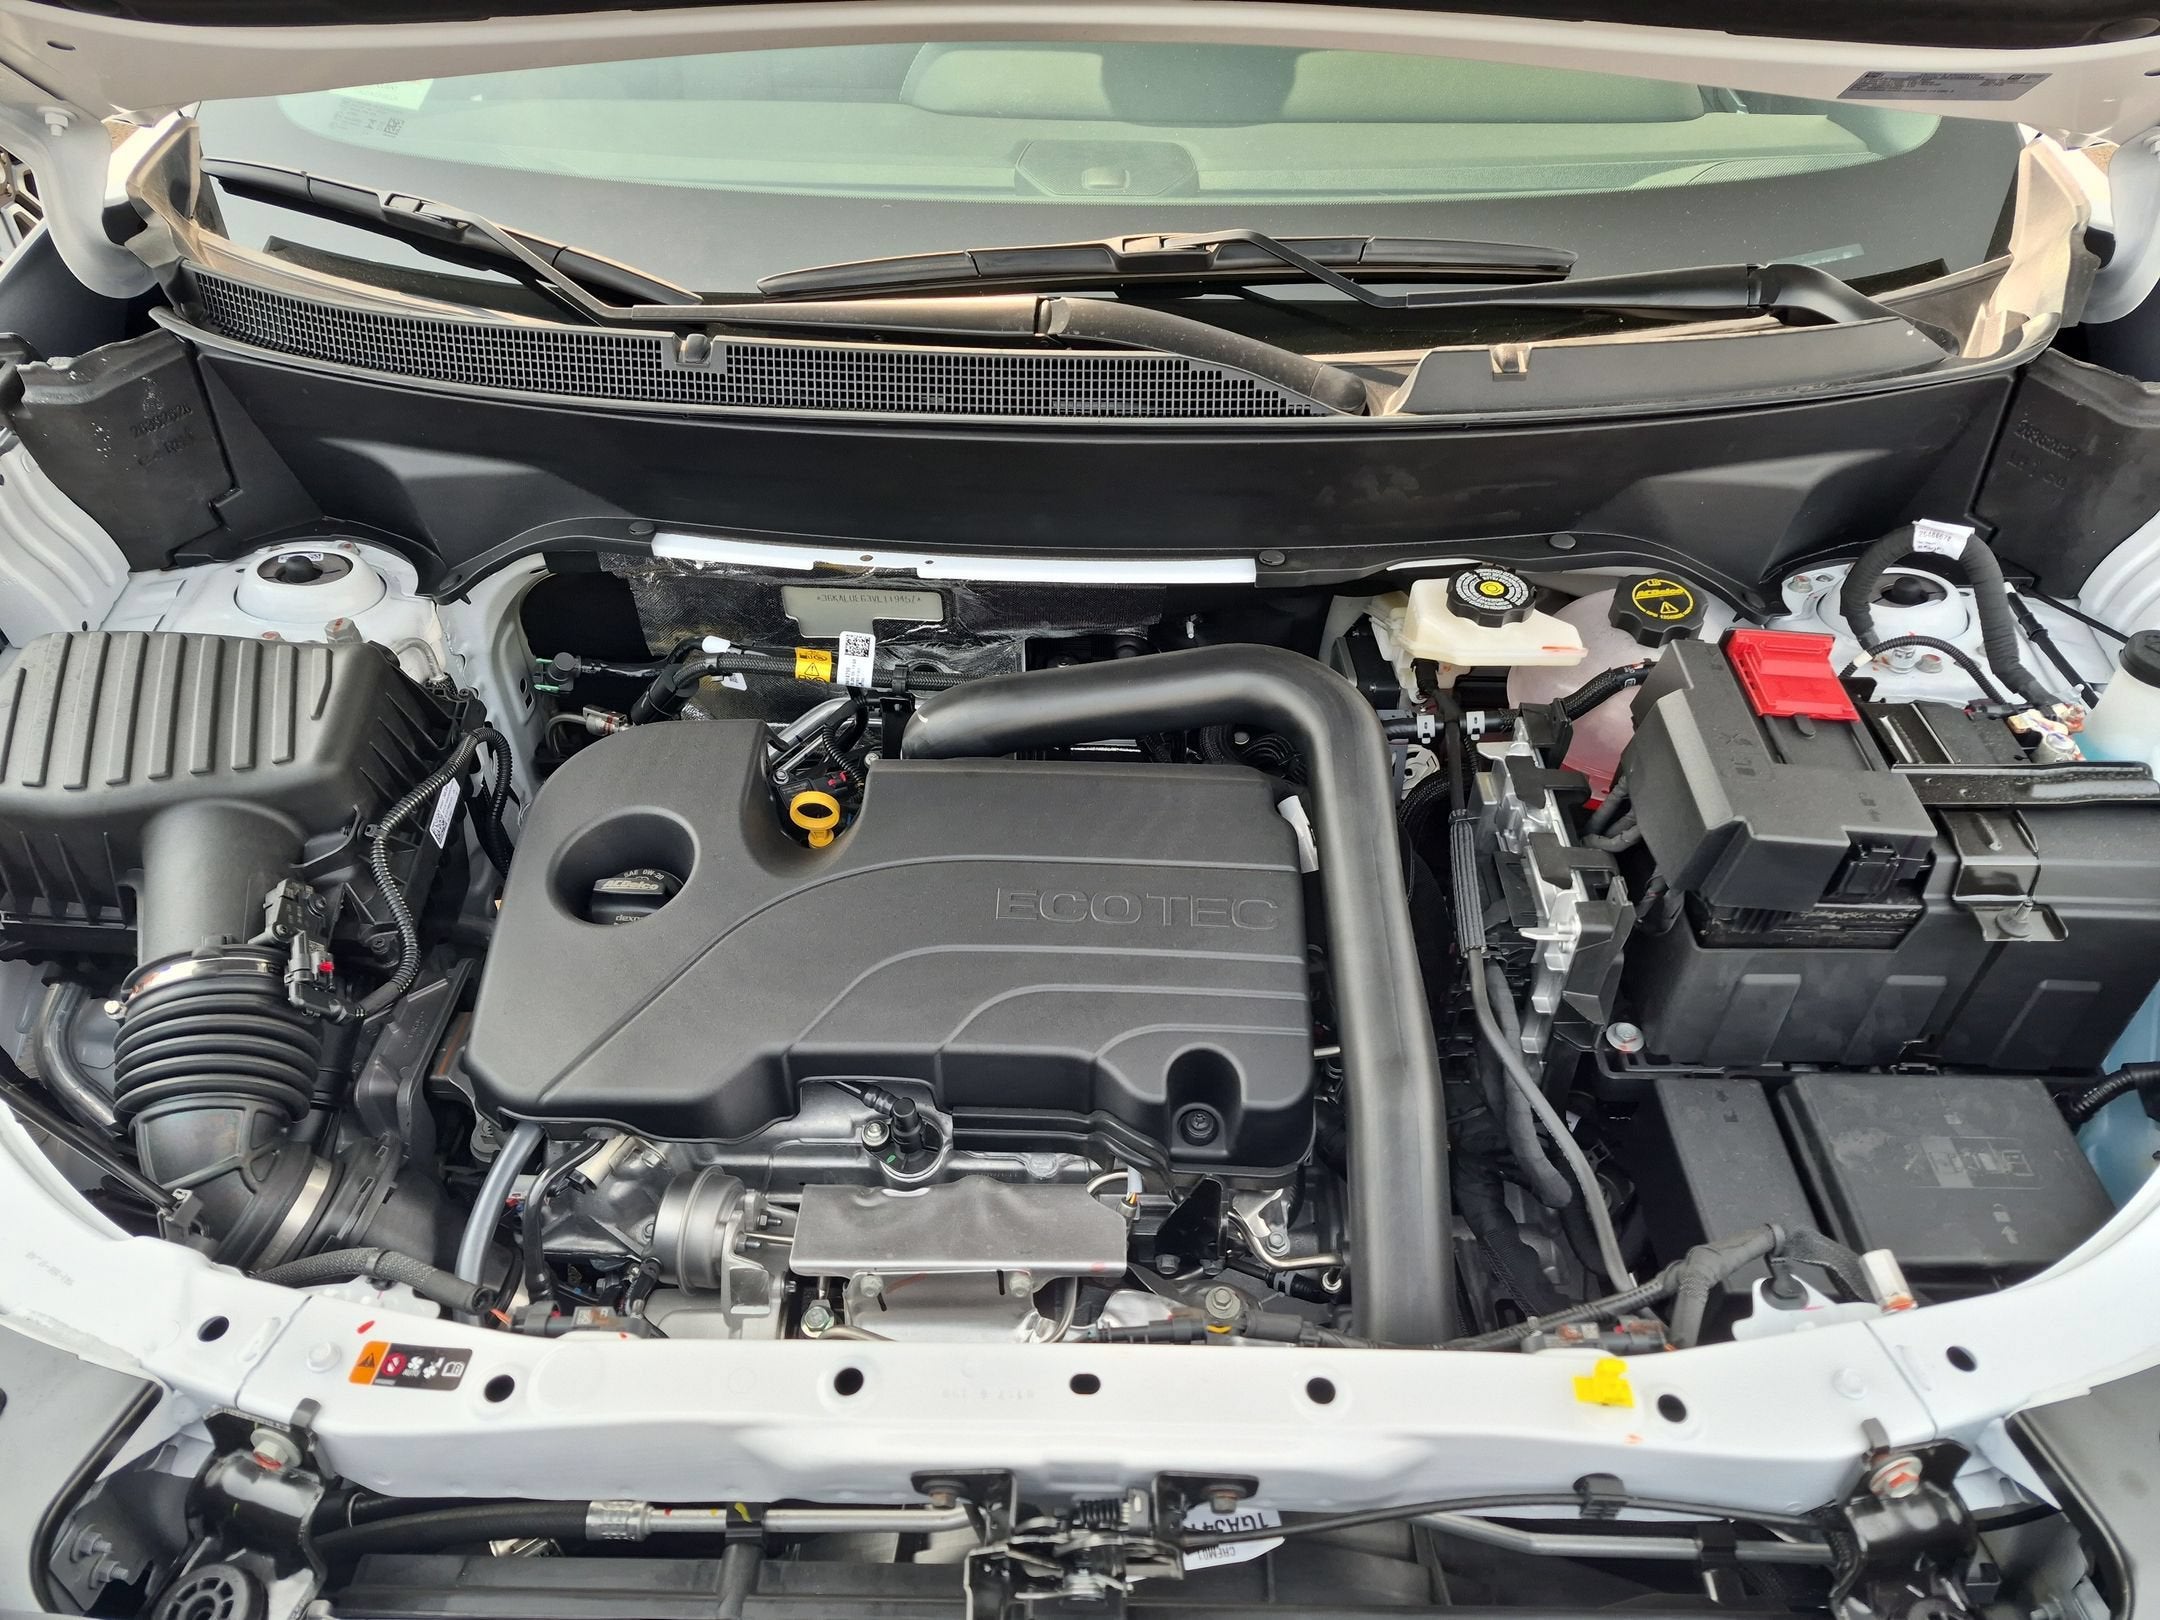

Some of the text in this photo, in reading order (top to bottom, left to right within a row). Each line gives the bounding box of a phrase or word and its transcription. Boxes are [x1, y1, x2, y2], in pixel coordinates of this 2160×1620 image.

[623, 868, 665, 881] SAE 0W-20
[600, 880, 660, 891] ACDelco
[995, 887, 1279, 931] ECOTEC
